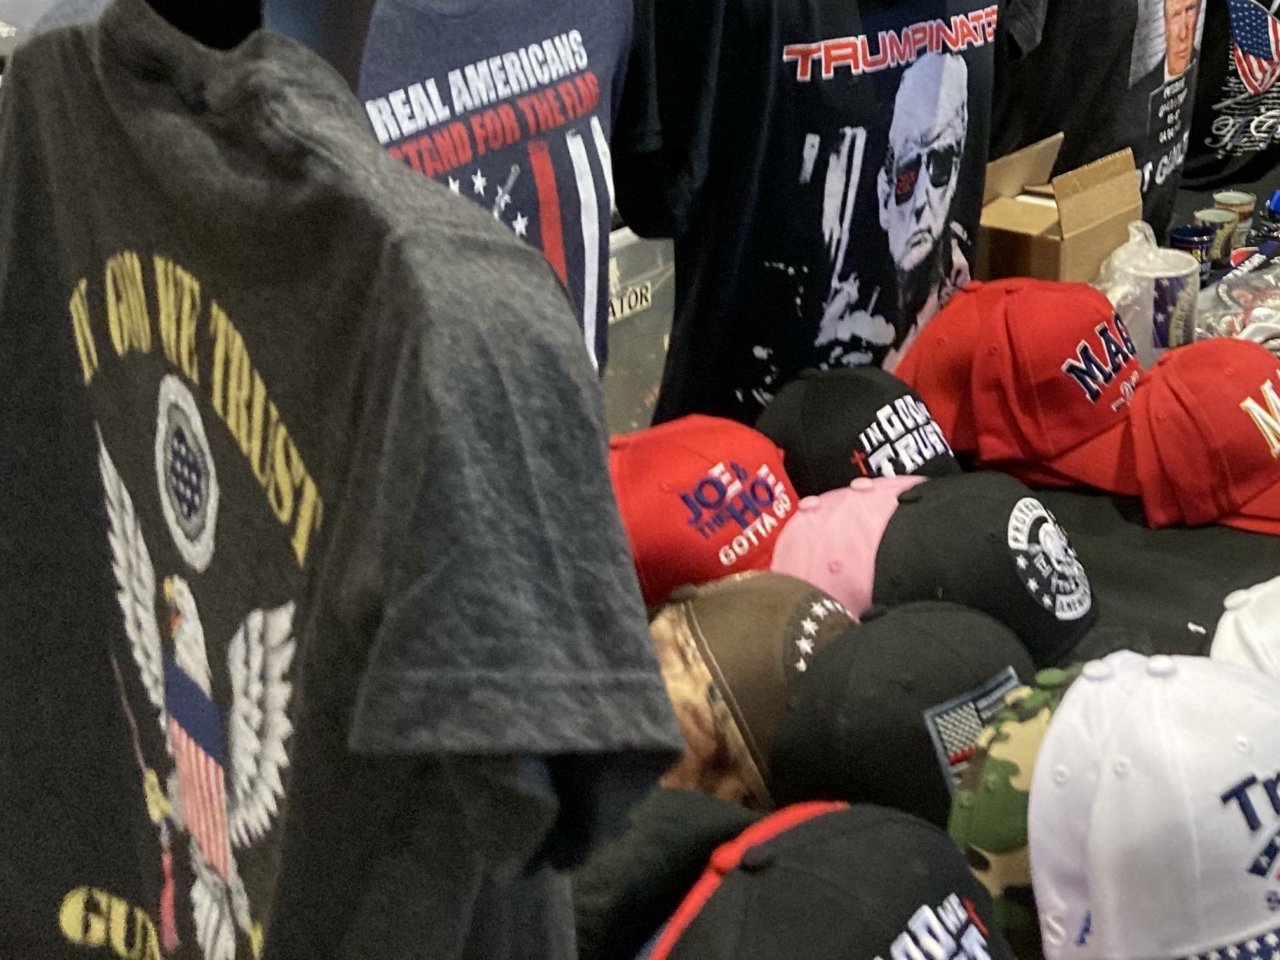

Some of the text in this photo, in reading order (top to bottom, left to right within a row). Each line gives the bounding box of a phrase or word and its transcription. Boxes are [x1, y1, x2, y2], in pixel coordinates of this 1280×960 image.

[365, 29, 589, 145] REAL AMERICANS
[469, 103, 521, 156] FOR
[517, 88, 566, 137] THE
[210, 297, 324, 570] TRUST
[858, 421, 886, 455] IN
[867, 419, 955, 478] TRUS
[679, 461, 743, 527] JOE
[718, 492, 792, 567] GOTTA GO
